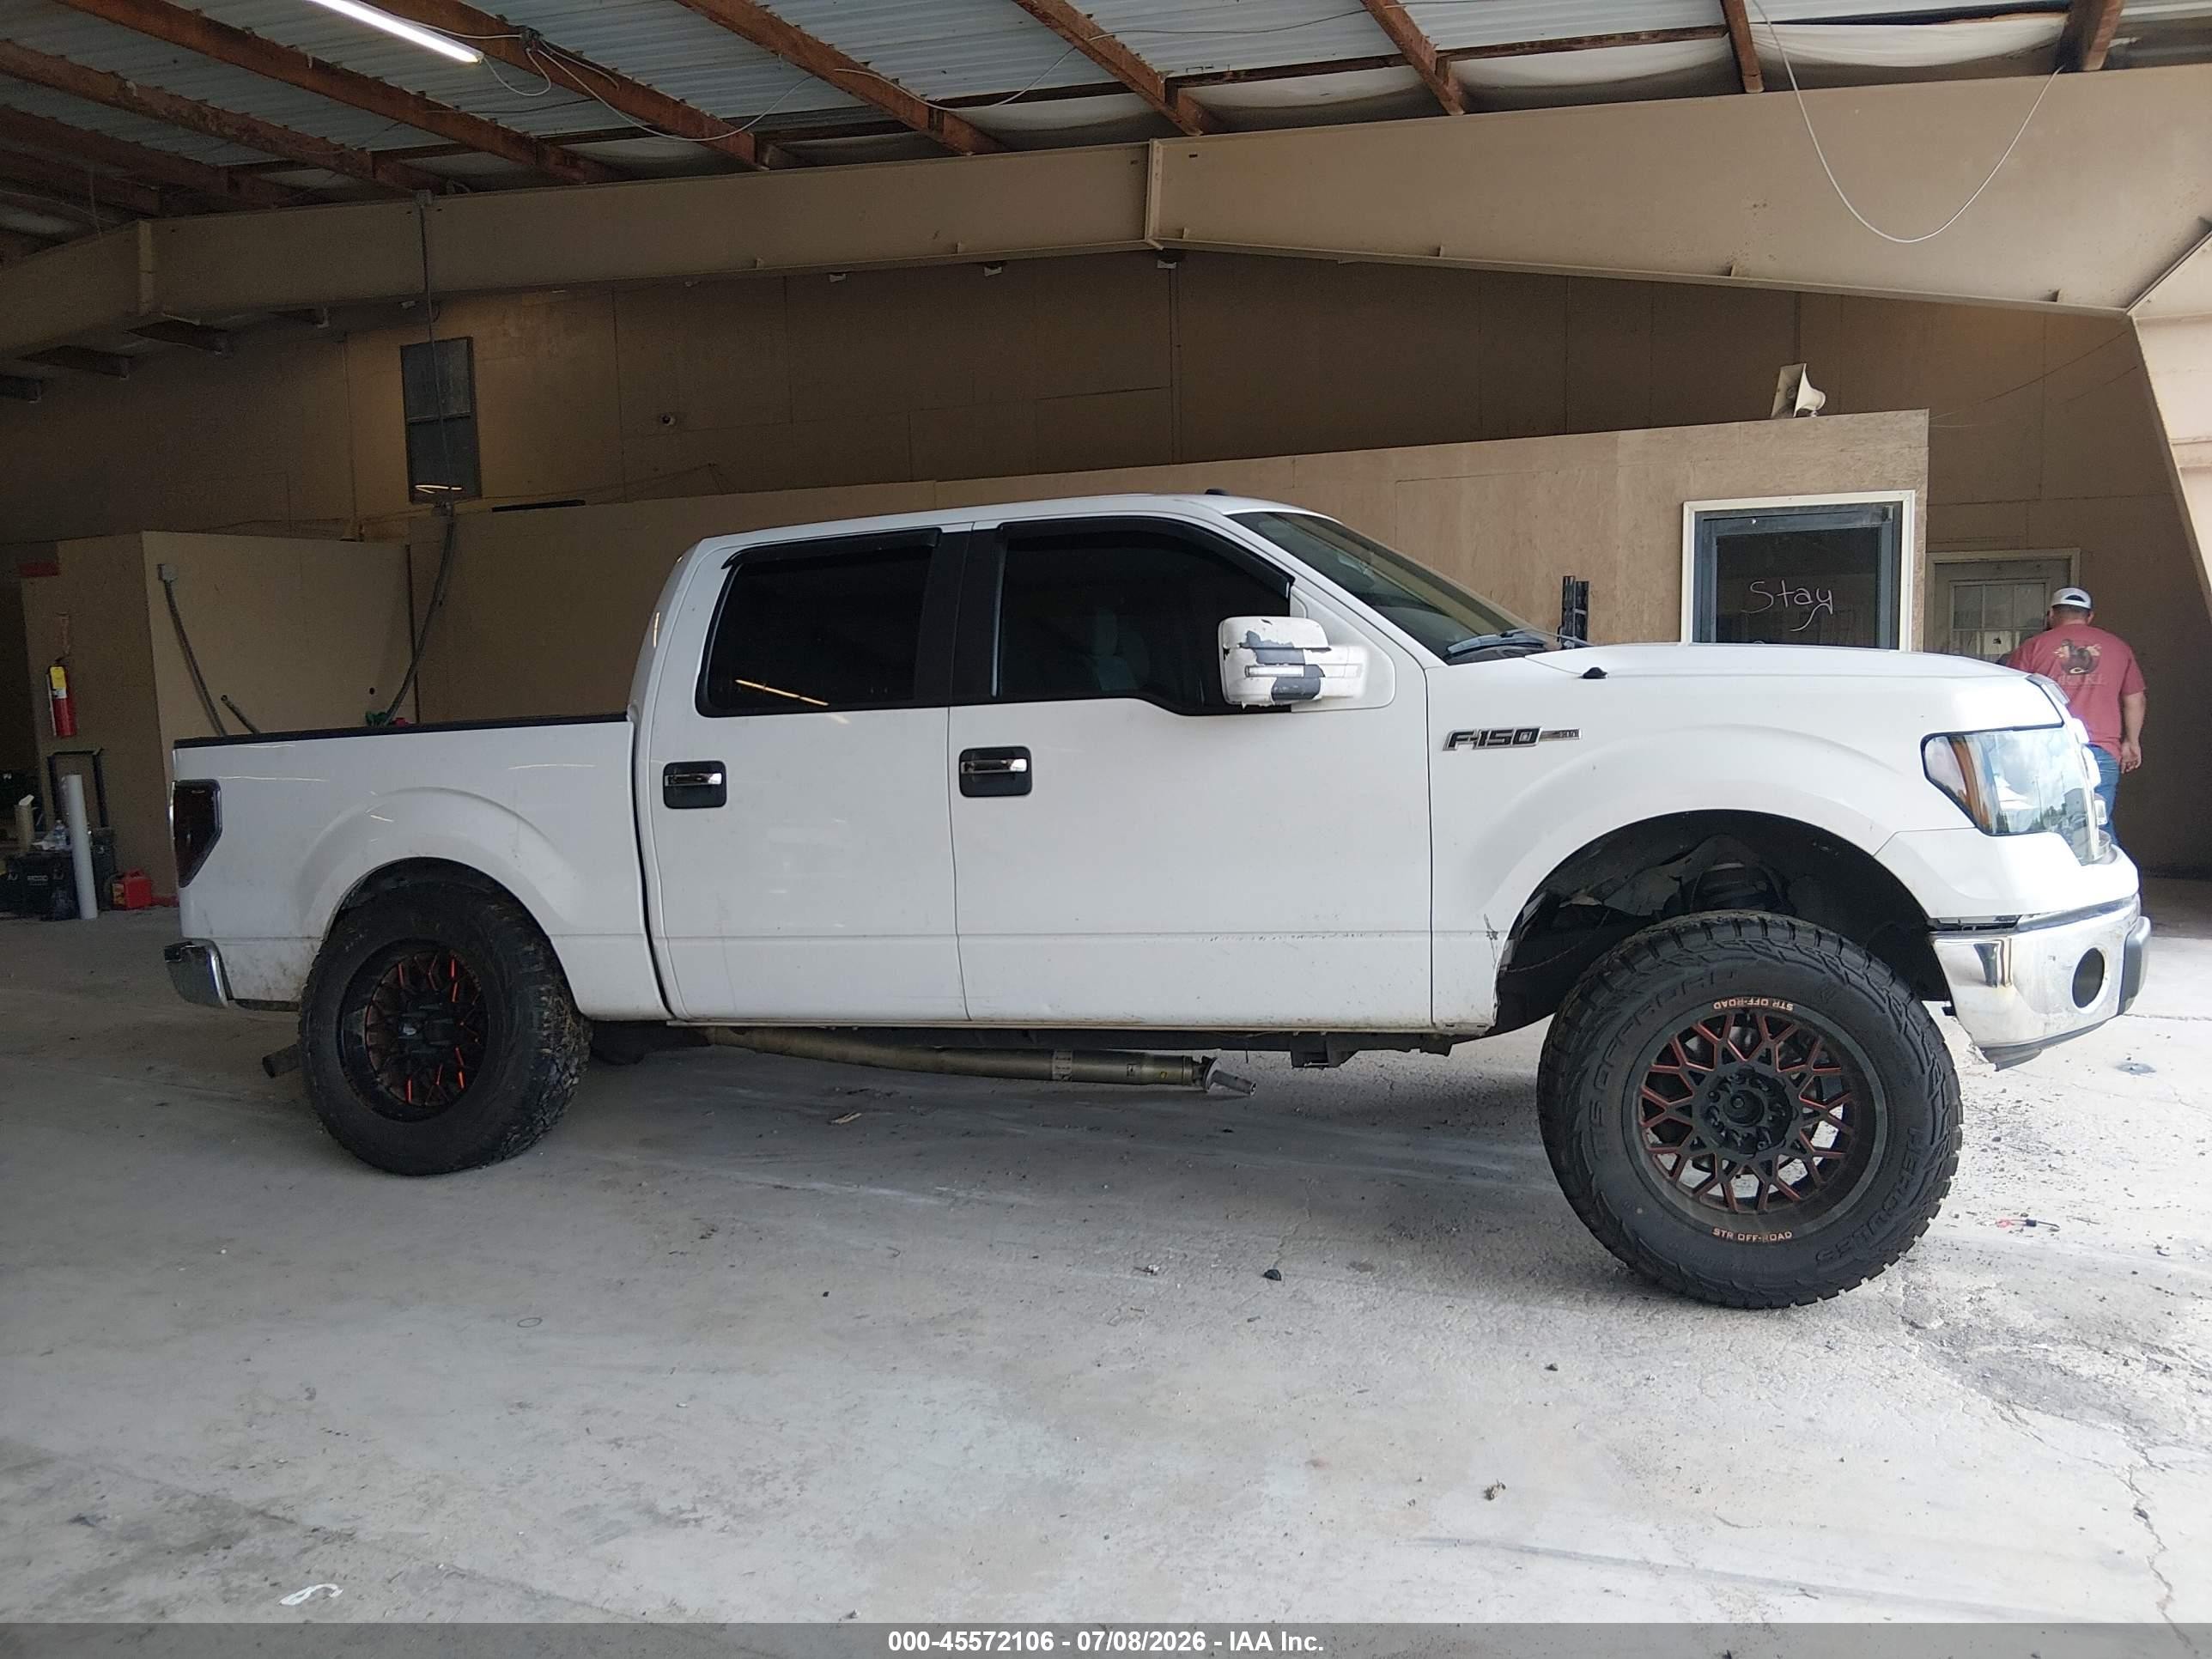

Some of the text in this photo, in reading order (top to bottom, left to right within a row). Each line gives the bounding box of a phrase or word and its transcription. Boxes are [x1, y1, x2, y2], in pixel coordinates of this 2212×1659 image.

[1740, 579, 1834, 633] Stay
[1443, 726, 1542, 751] F-150
[1712, 1228, 1793, 1243] STR OFF-ROAD
